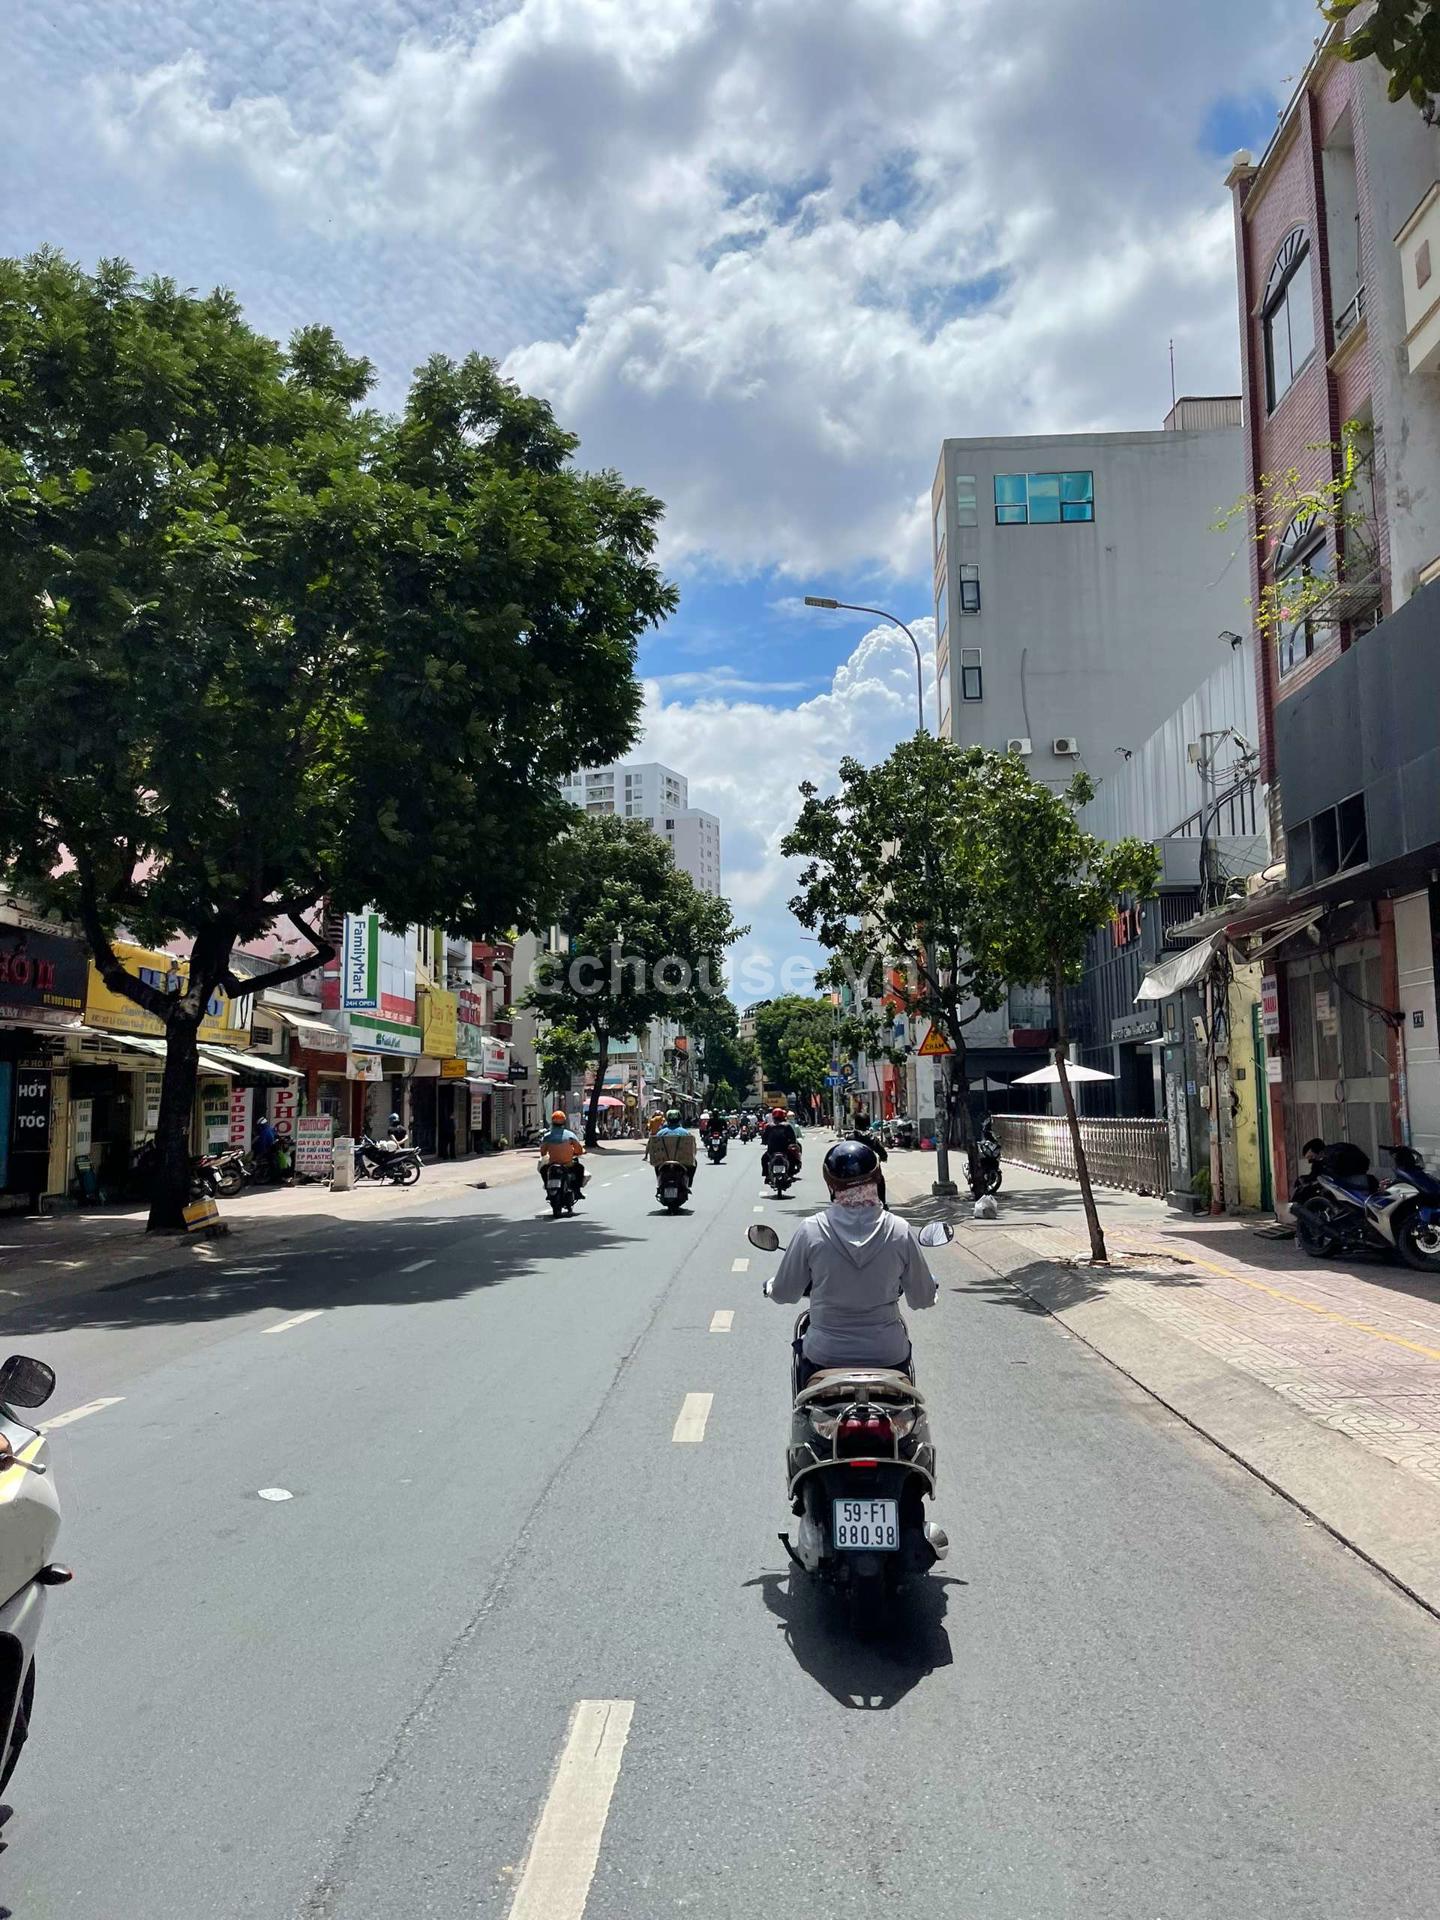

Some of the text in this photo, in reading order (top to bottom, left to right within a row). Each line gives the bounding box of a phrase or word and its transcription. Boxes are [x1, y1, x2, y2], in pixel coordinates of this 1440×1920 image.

[350, 921, 366, 993] FamilyMart
[18, 1078, 47, 1097] HỚT
[18, 1109, 46, 1128] TÓC
[844, 1503, 886, 1523] 59-F1
[838, 1525, 895, 1546] 880.98
